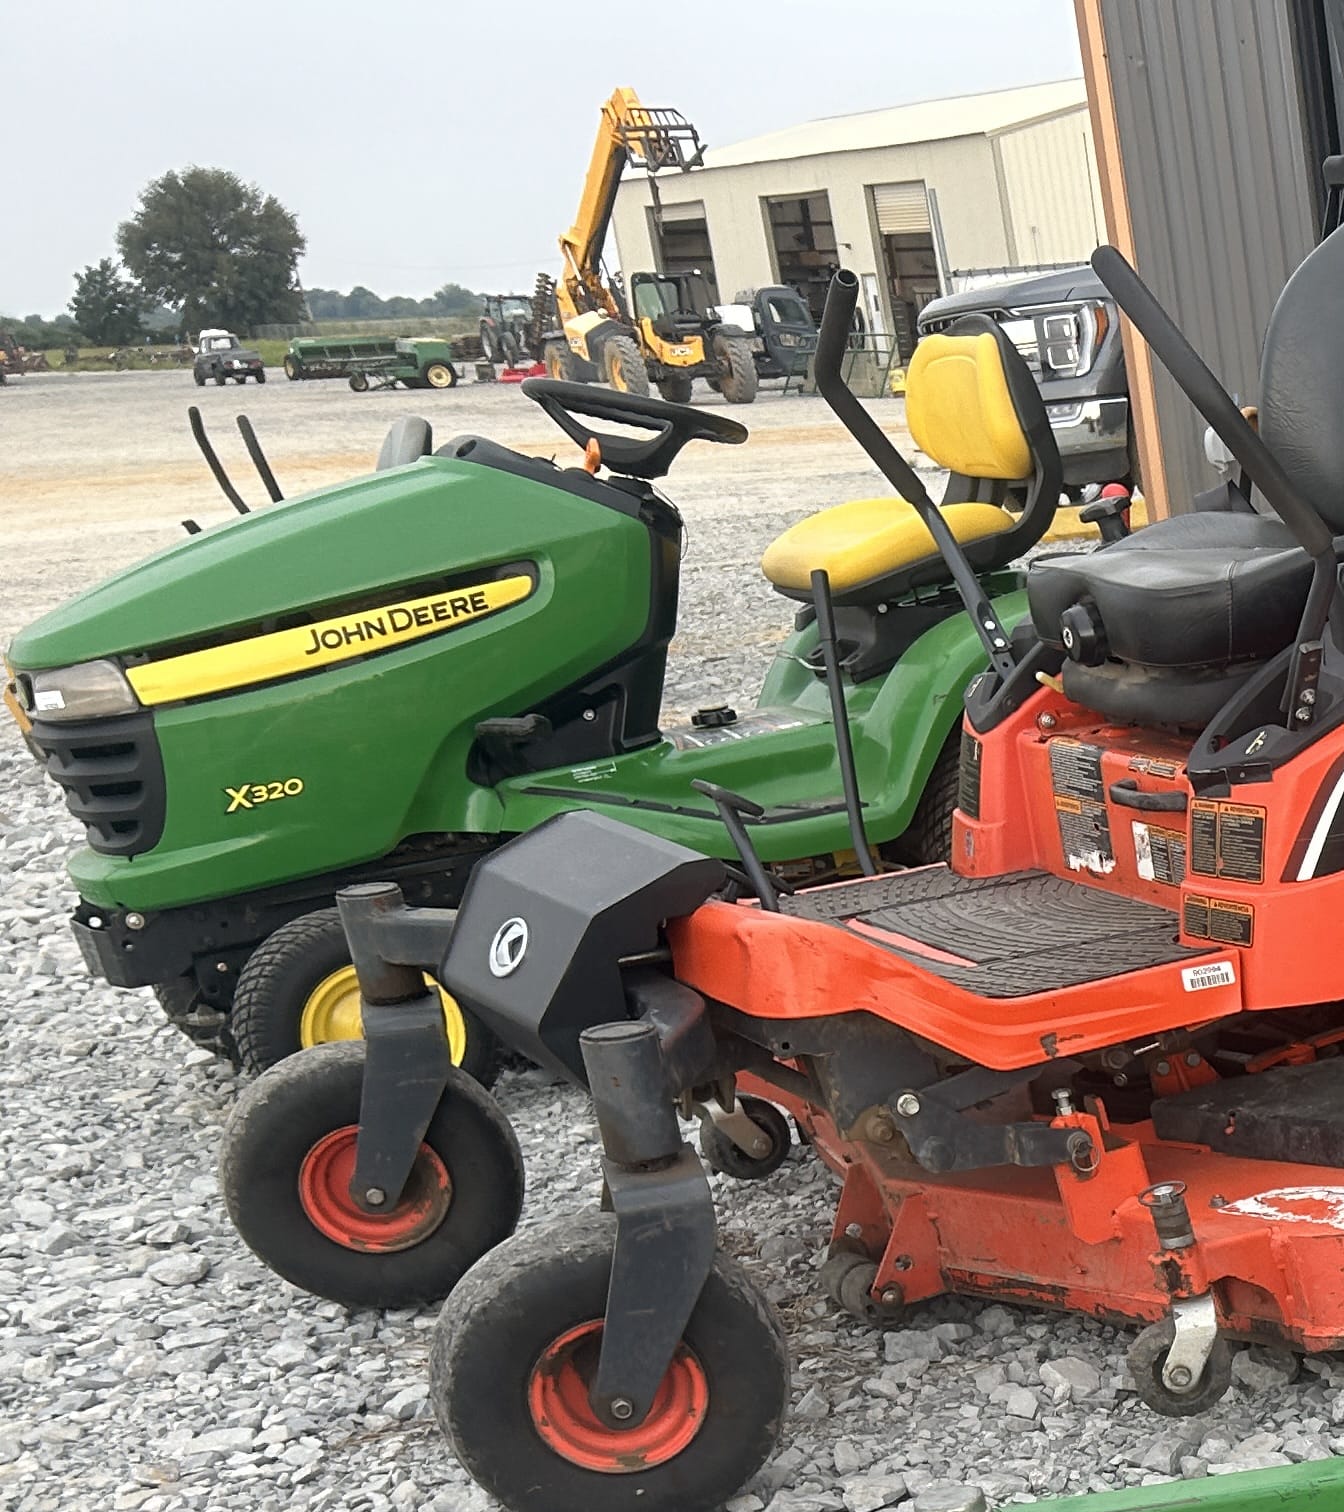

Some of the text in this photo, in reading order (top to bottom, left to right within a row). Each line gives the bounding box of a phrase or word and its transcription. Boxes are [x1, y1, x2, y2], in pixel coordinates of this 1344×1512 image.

[305, 590, 489, 655] JOHN DEERE
[224, 777, 304, 814] X320
